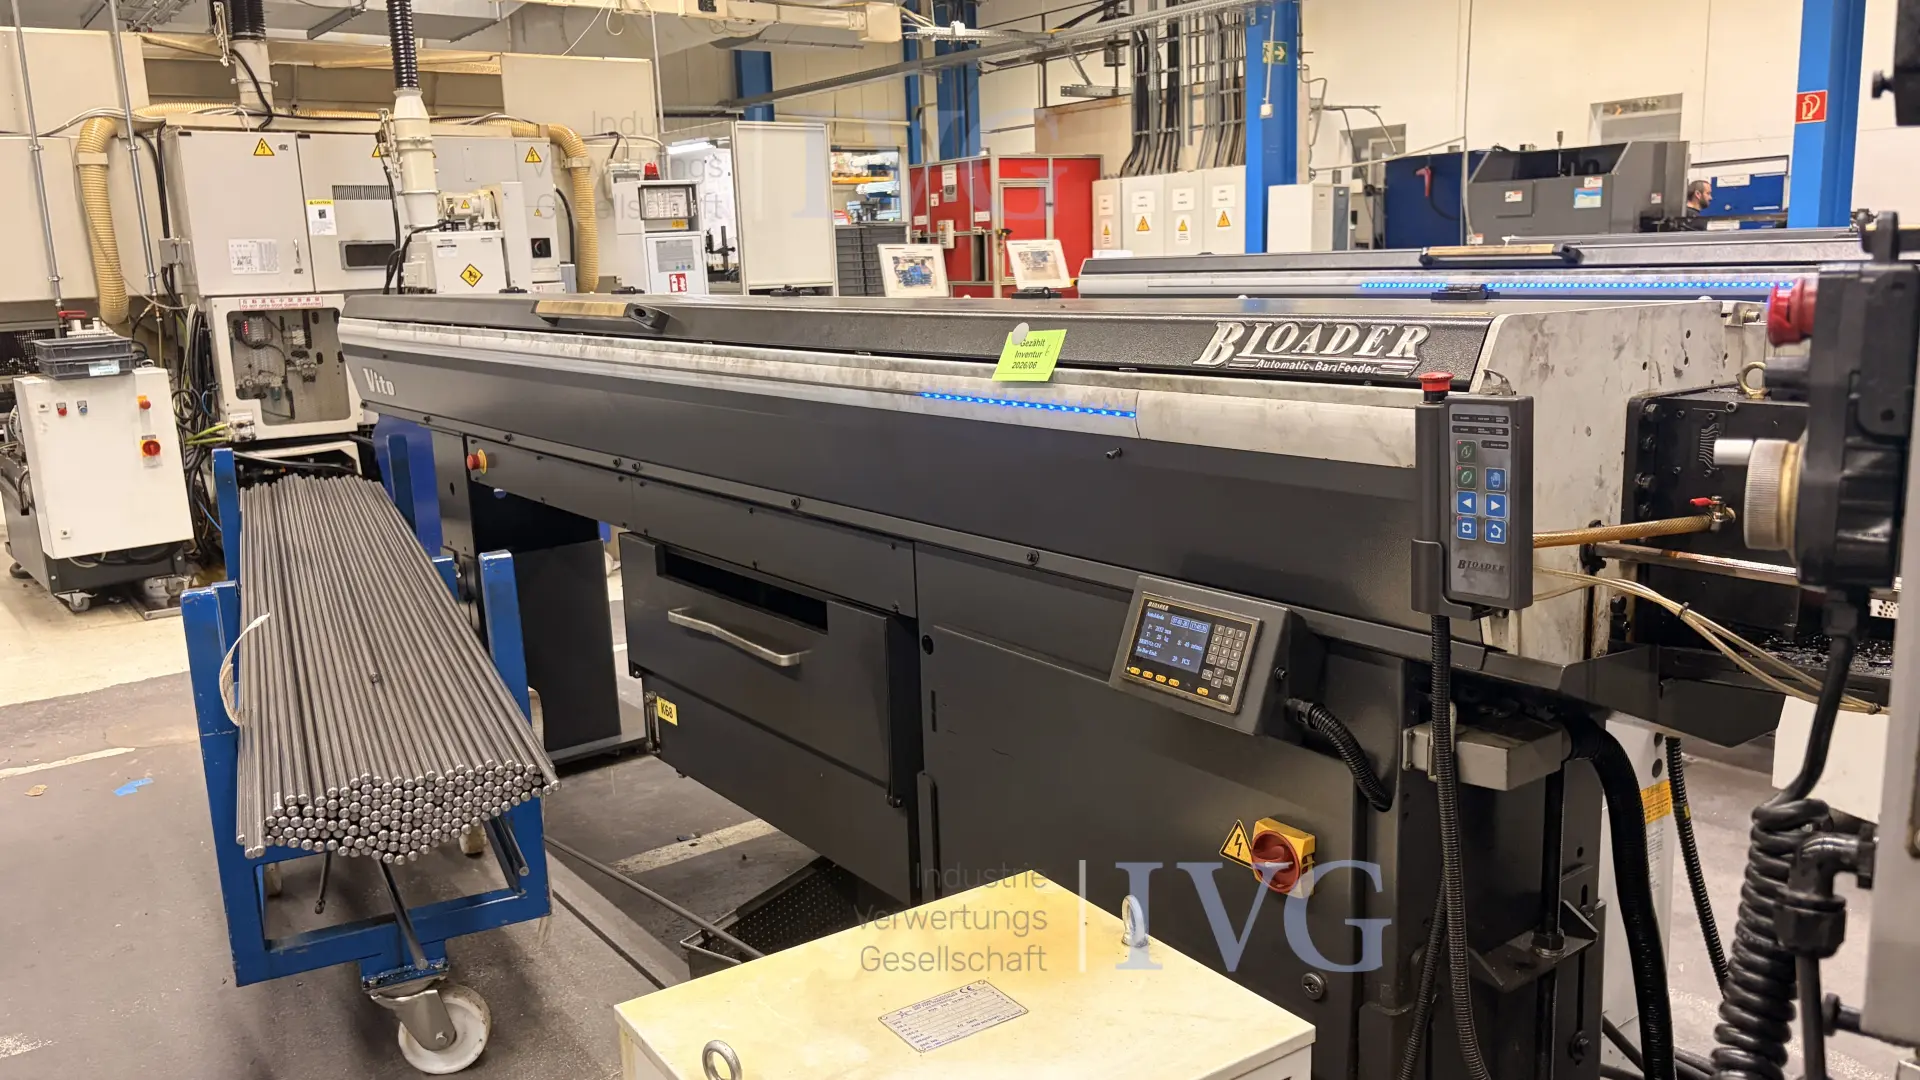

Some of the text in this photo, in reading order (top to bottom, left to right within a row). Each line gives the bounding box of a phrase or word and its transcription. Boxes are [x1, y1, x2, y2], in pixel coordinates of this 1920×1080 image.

[1020, 338, 1046, 347] Gezählt
[1014, 350, 1043, 358] Inventur
[1256, 358, 1312, 371] Automatic
[362, 367, 395, 396] Vito
[660, 701, 674, 719] K68
